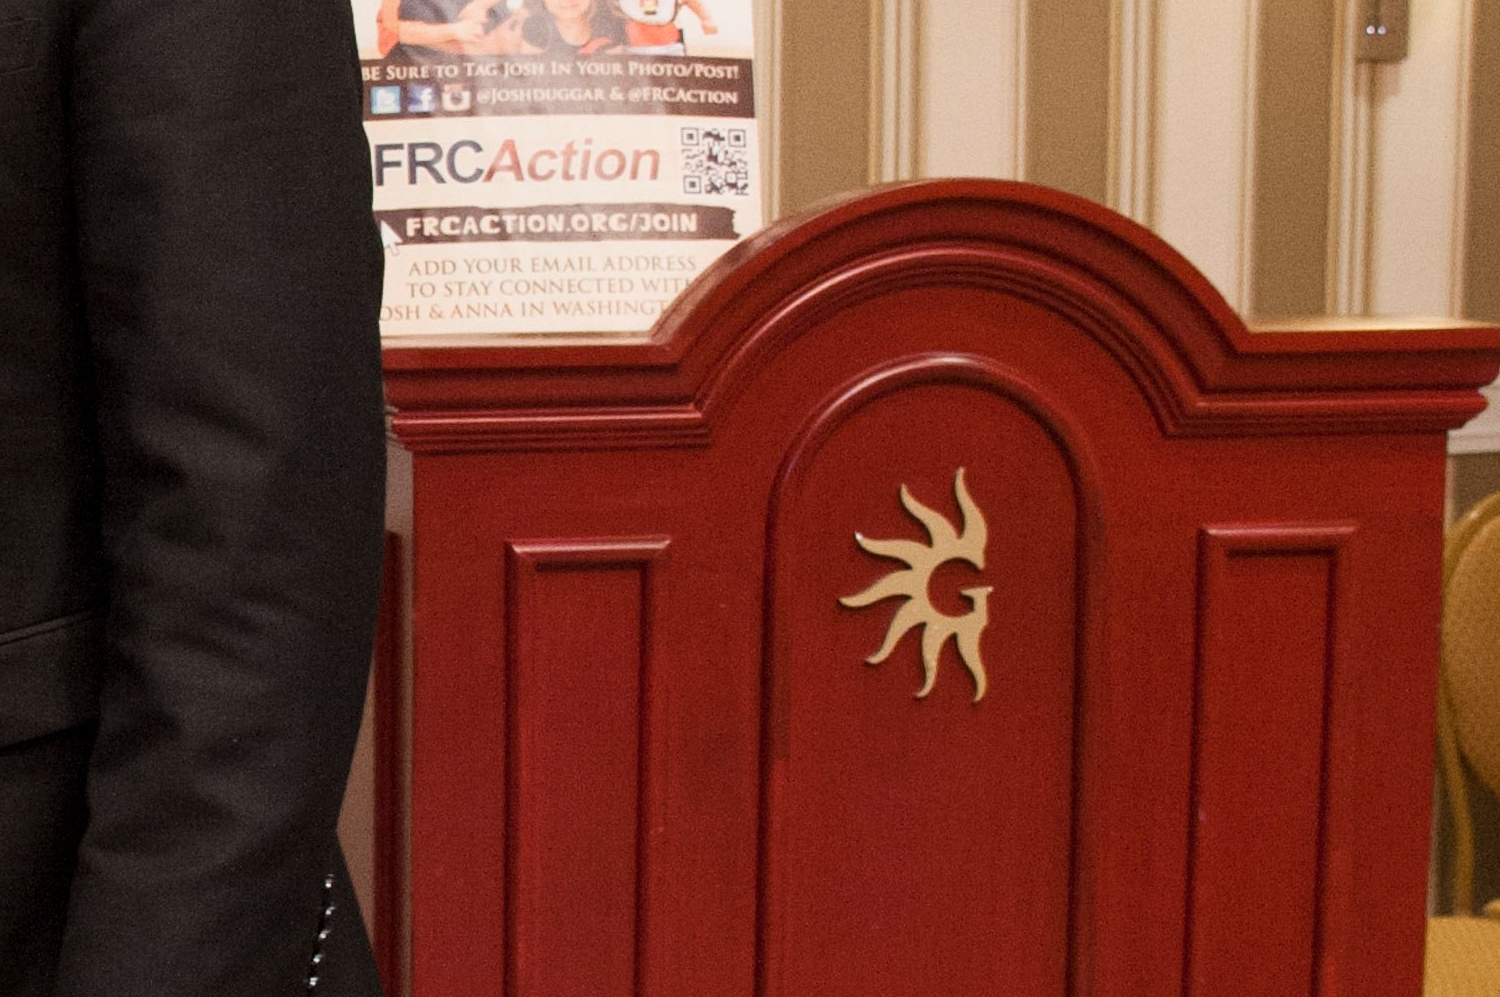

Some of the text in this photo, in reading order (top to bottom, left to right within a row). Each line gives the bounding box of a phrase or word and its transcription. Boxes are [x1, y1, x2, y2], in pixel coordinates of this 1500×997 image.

[386, 63, 430, 81] SURE
[436, 63, 459, 79] TO
[463, 61, 498, 78] TAG
[503, 61, 546, 79] JOSH
[551, 60, 573, 77] IN
[575, 60, 623, 77] YOUR
[628, 61, 740, 80] PHOTO/POST!
[610, 86, 625, 102] &
[628, 87, 739, 105] @FRCACTION
[375, 138, 661, 187] FRCAction
[405, 211, 698, 237] FRCACTION.ORG/JOIN
[409, 256, 697, 277] ADD YOUR EMAIL ADDRESS
[407, 281, 437, 299] TO
[444, 280, 492, 297] STAY
[499, 277, 634, 296] CONNECTED
[380, 299, 668, 322] OSH & ANNA IN WASHINGT
